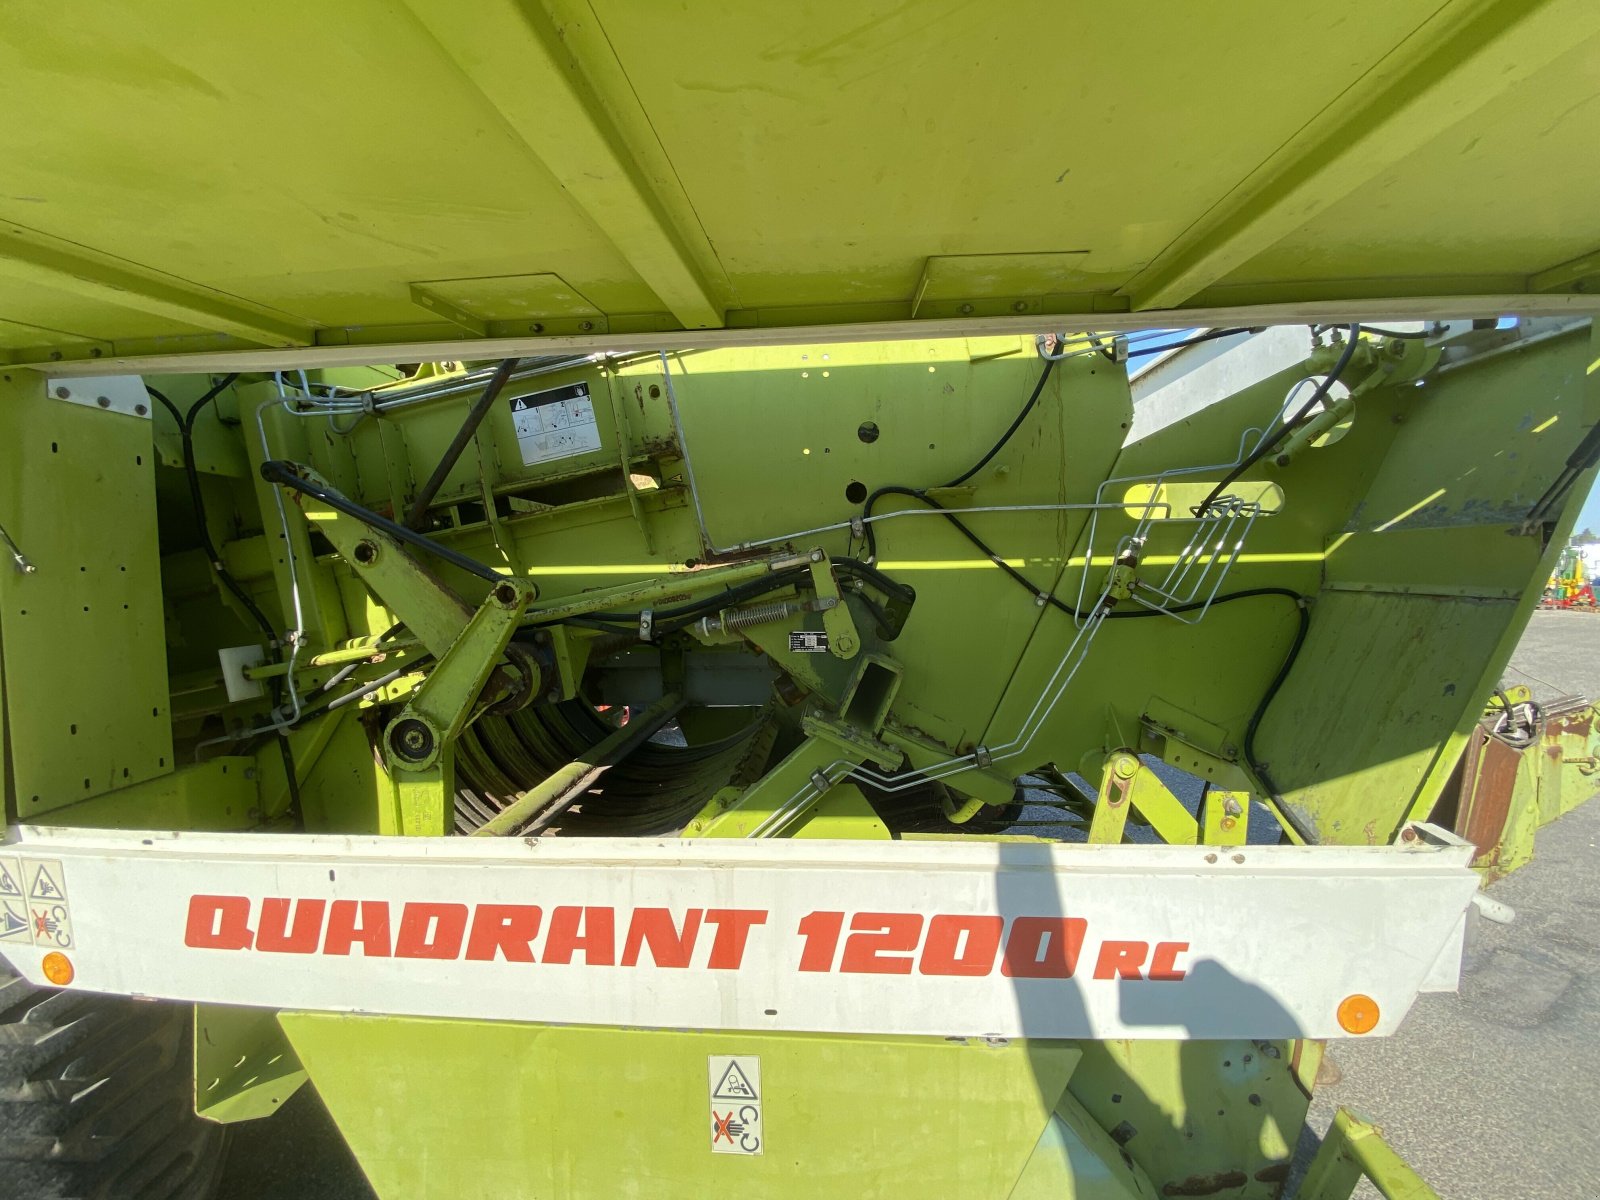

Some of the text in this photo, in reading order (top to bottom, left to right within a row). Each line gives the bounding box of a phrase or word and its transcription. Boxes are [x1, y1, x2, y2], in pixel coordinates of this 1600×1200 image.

[184, 894, 1190, 981] QUADRANT 1200 RC
